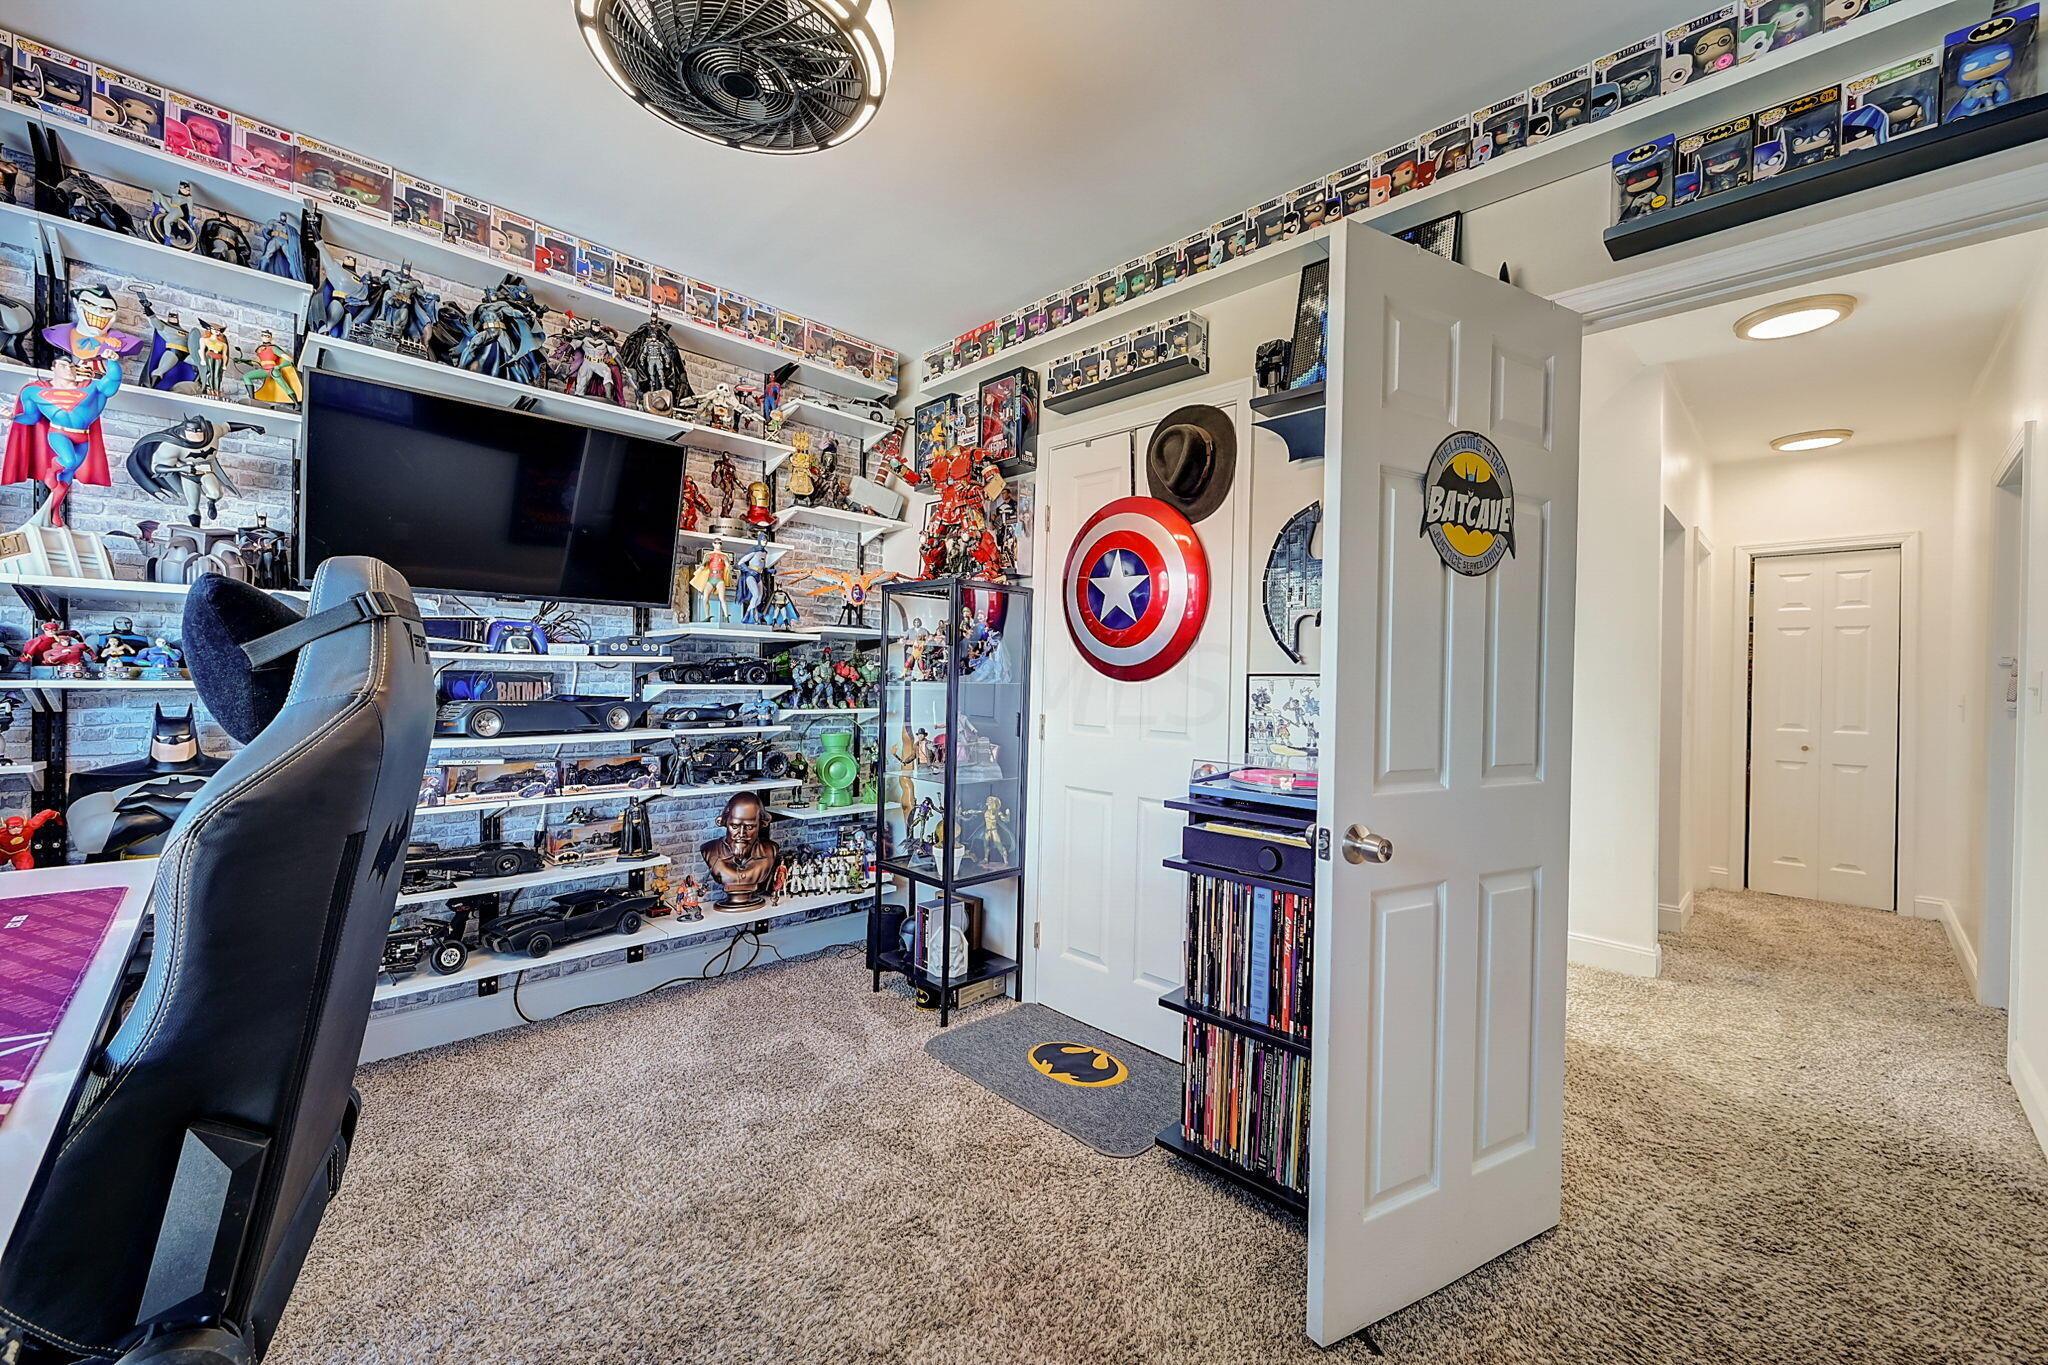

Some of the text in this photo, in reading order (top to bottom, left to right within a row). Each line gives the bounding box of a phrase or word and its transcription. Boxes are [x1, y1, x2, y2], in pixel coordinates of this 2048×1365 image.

[1917, 56, 1932, 67] 355
[1437, 436, 1506, 477] WELCOME TO THE
[1426, 485, 1513, 533] BATCAVE
[1433, 529, 1502, 570] JUSTICE SERVED DAILY
